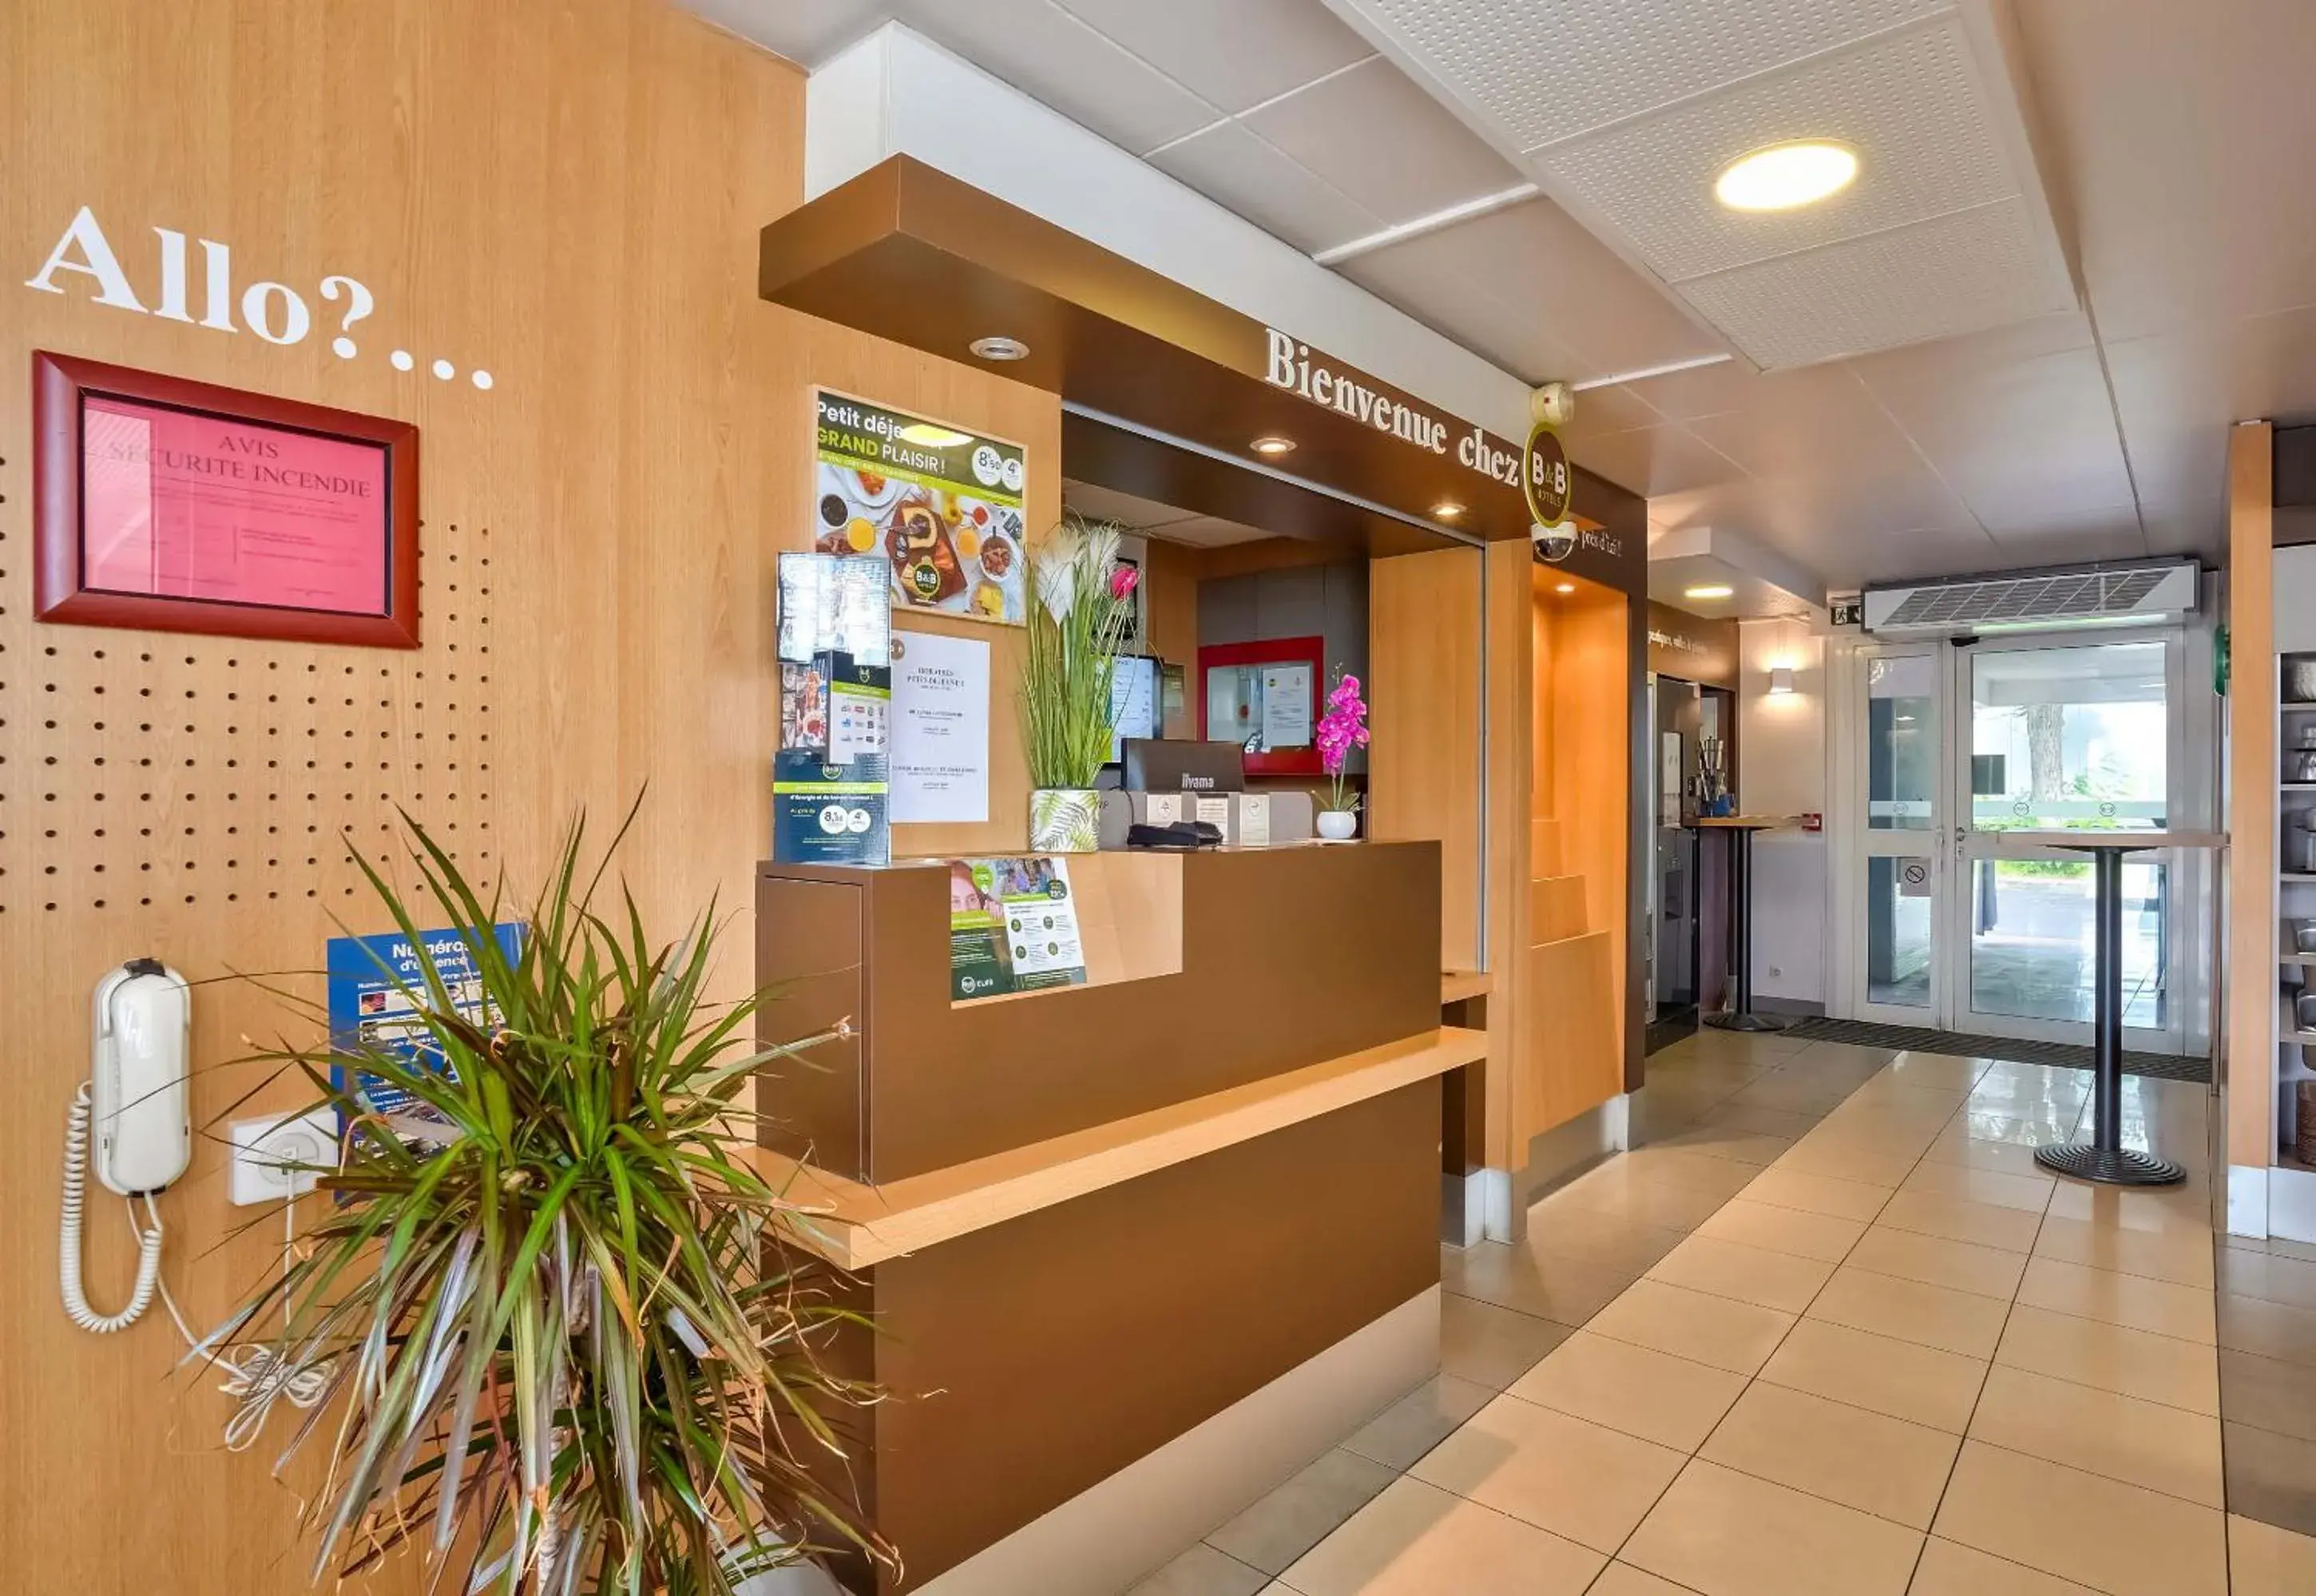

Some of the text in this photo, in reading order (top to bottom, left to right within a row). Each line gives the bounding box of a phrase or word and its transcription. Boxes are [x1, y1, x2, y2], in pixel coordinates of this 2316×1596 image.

[818, 400, 860, 429] Petit
[1265, 328, 1518, 488] Bienvenue chez
[218, 436, 279, 459] AVIS
[819, 426, 878, 457] GRAND
[882, 444, 938, 473] PLAISIR
[253, 464, 371, 499] INCENDIE
[1533, 450, 1566, 495] B&B
[1182, 773, 1214, 788] iiyama
[400, 957, 466, 972] d'uence
